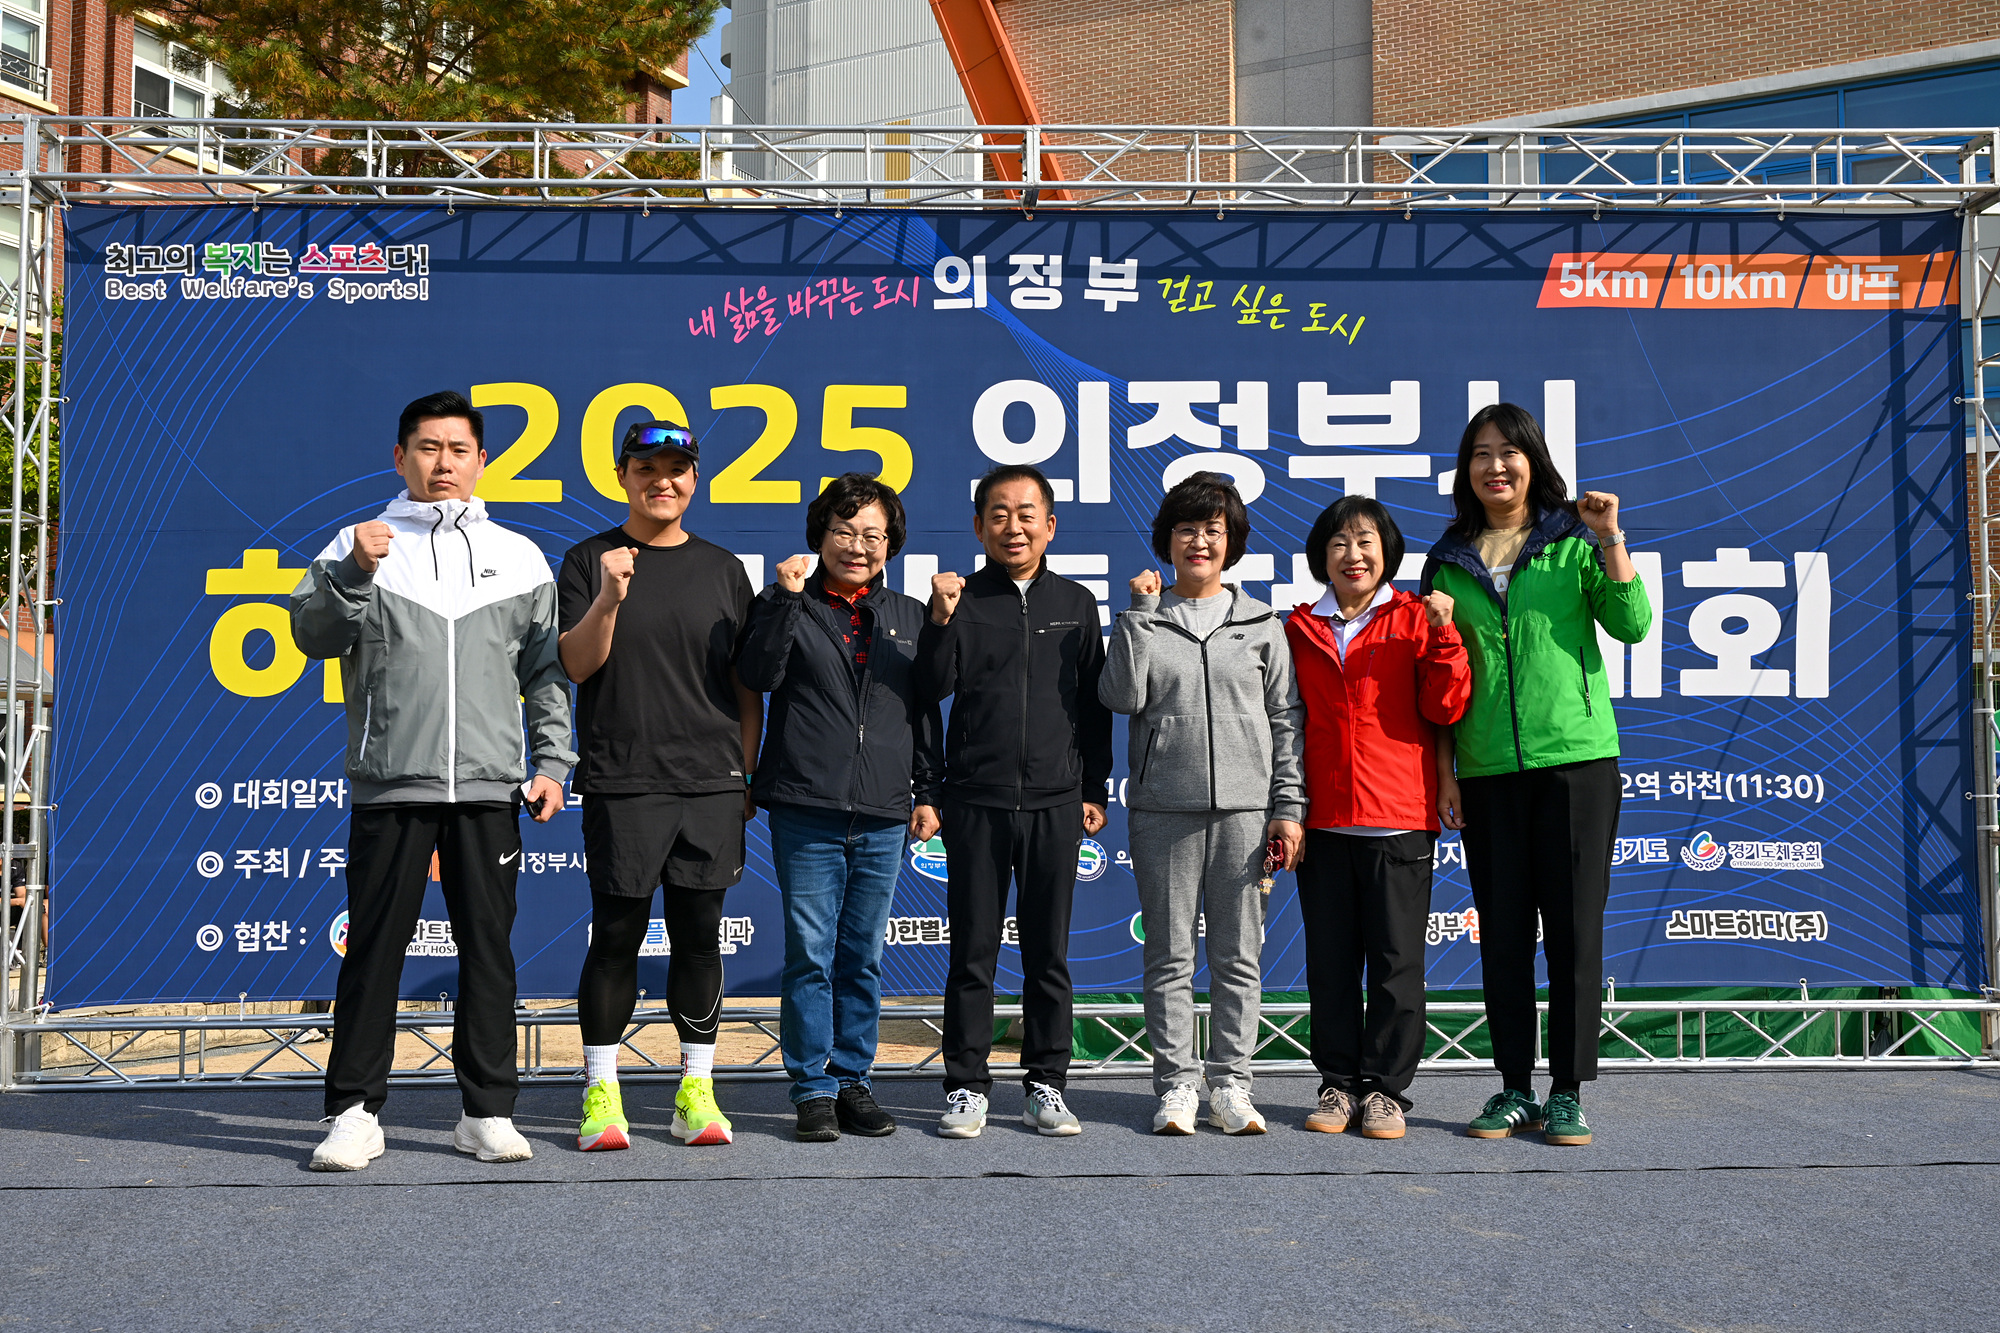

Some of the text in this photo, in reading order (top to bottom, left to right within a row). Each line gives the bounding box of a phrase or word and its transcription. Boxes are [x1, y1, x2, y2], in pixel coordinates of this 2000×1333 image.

[106, 243, 429, 276] 최고의 복지는 스포츠다!
[106, 277, 429, 302] Best Welfare's Sports!
[1558, 262, 1900, 302] 5km 10km 하프
[689, 254, 1366, 345] 내 삶을 바꾸는 도시 의정부 걷고 싶은 도시
[470, 382, 914, 504] 2025
[233, 778, 348, 810] 대회일자
[1620, 770, 1825, 803] 오역 하천(11:30)
[234, 847, 289, 879] 주최
[318, 848, 348, 878] 주
[1730, 842, 1821, 860] 경기도체육회
[234, 921, 291, 952] 협찬
[1667, 911, 1826, 940] 스마트하다(주)
[407, 944, 428, 953] ART
